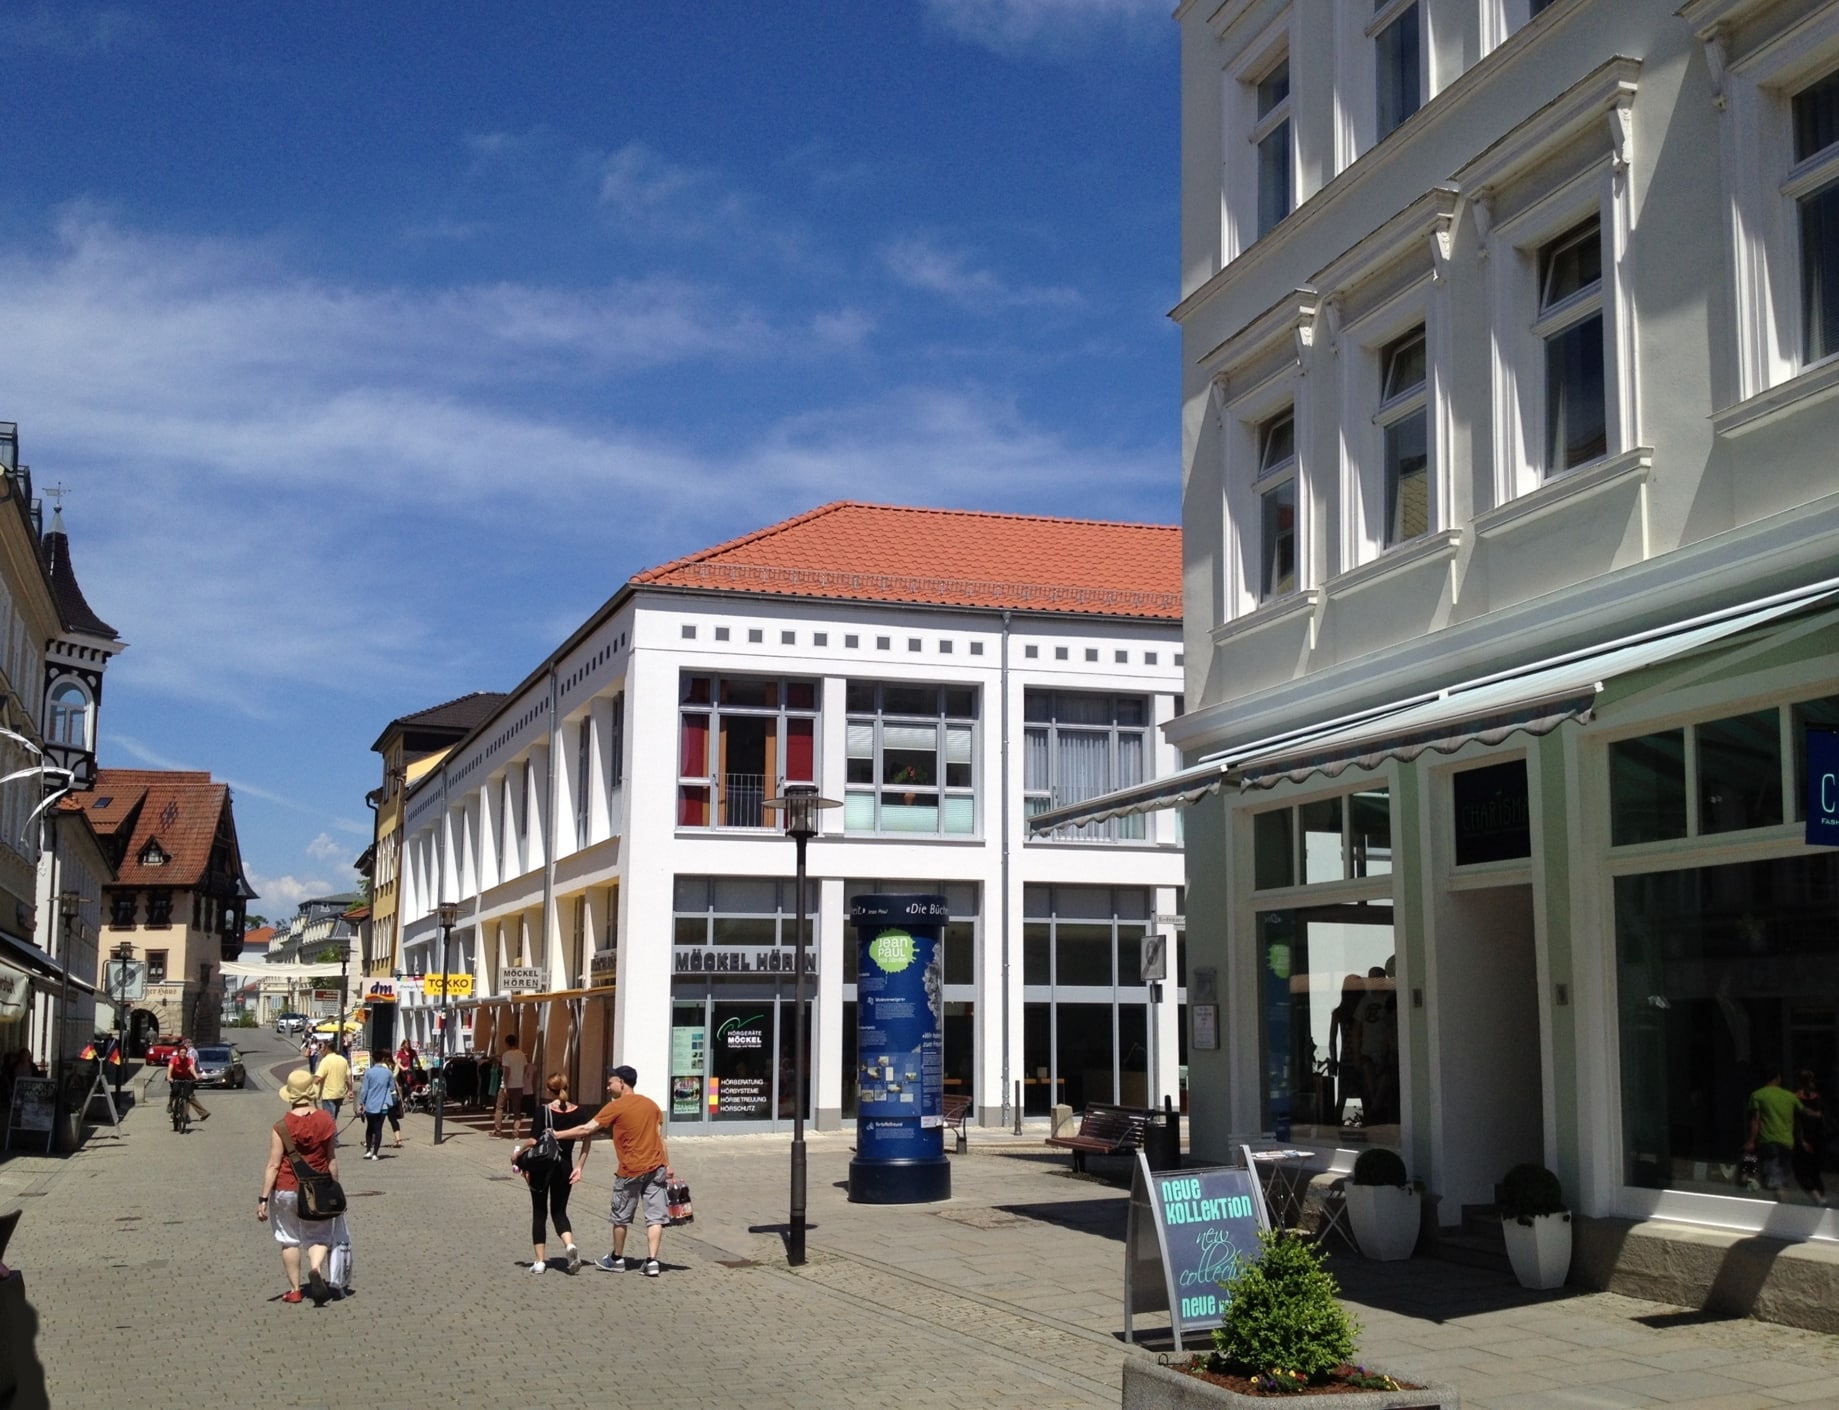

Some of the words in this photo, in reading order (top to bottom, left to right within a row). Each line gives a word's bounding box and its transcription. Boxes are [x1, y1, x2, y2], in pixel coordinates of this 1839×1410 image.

[675, 948, 751, 972] MÖCKEL
[756, 949, 817, 972] HÖRN
[503, 969, 539, 977] MÖCKEL
[503, 978, 539, 987] HÖREN
[370, 981, 392, 994] dm
[727, 1036, 762, 1044] MÖCKEL
[721, 1078, 764, 1086] HÖRBERATUNG
[721, 1087, 759, 1095] HÖRSYSTEME
[720, 1095, 767, 1103] HÖRBETREUUNG
